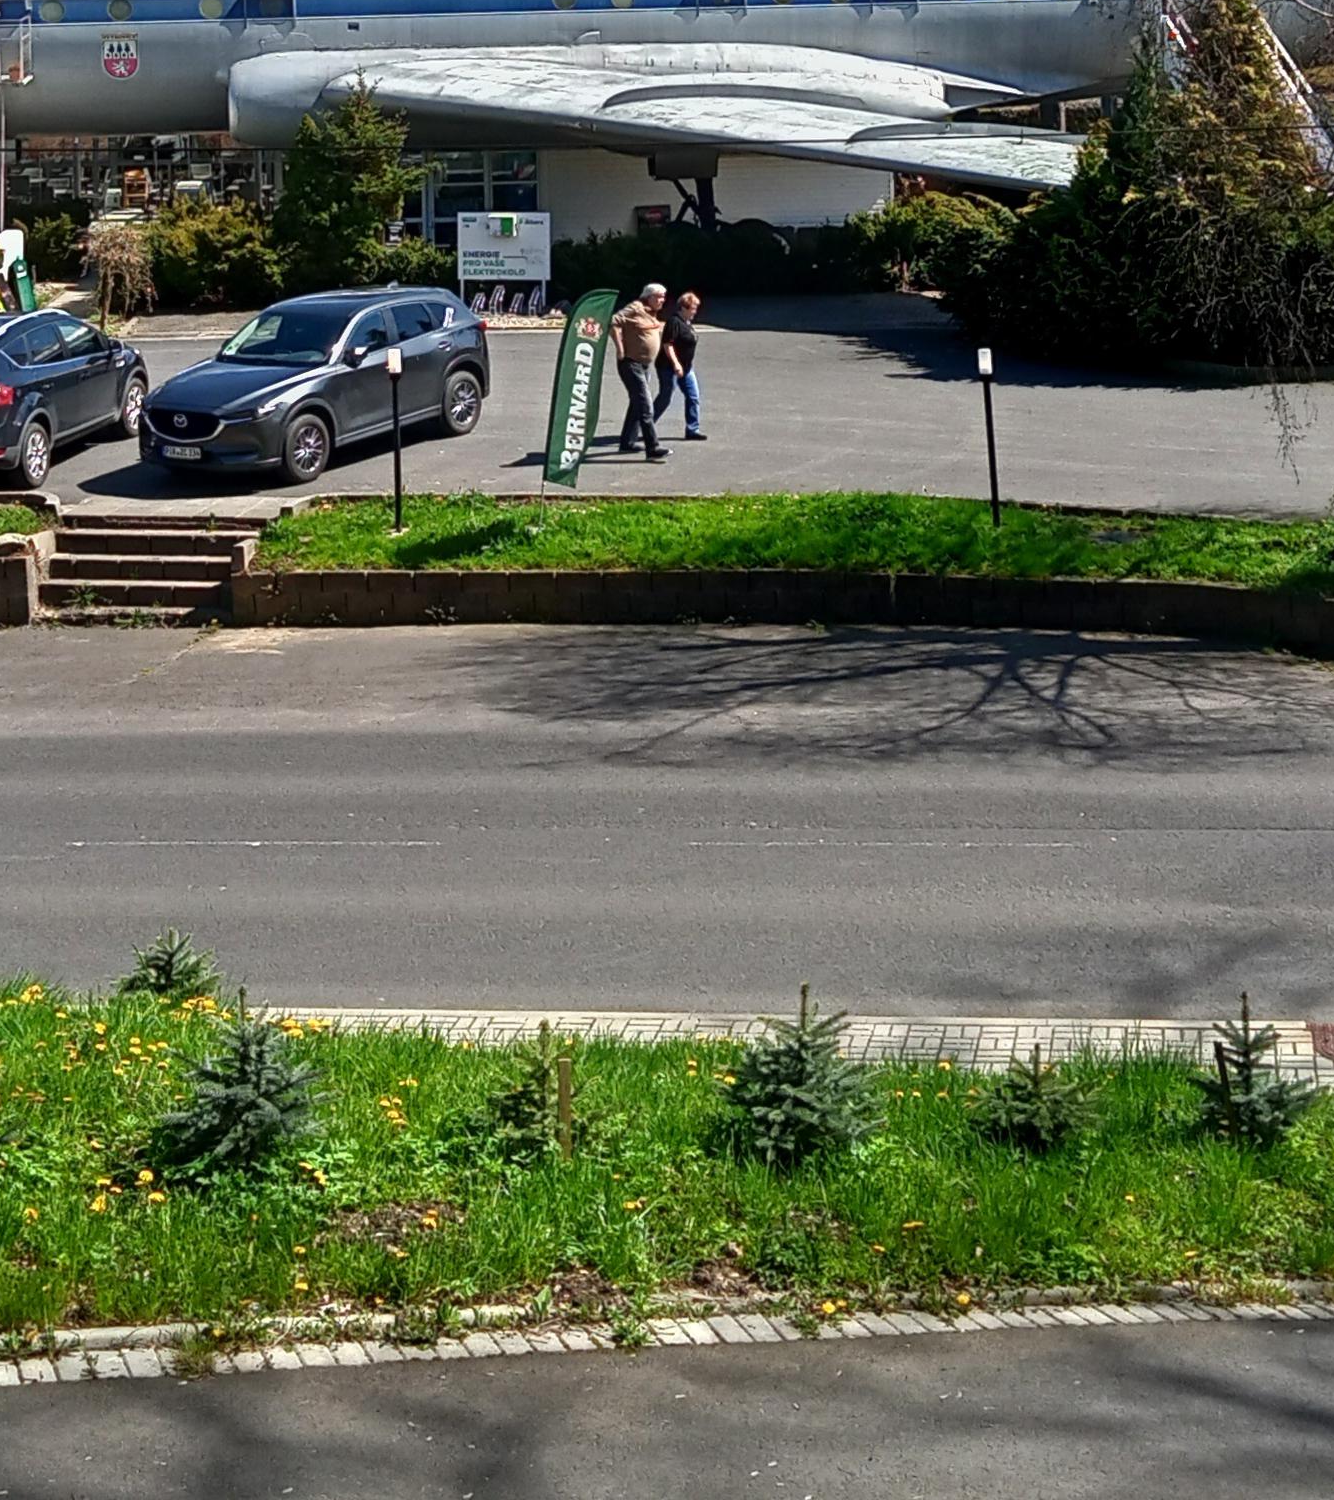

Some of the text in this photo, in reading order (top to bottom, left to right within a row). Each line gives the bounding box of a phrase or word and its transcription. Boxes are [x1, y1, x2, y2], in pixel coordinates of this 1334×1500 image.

[462, 259, 481, 267] PRO
[462, 268, 526, 276] ELEKTROKOLO
[559, 342, 595, 470] BERNARD
